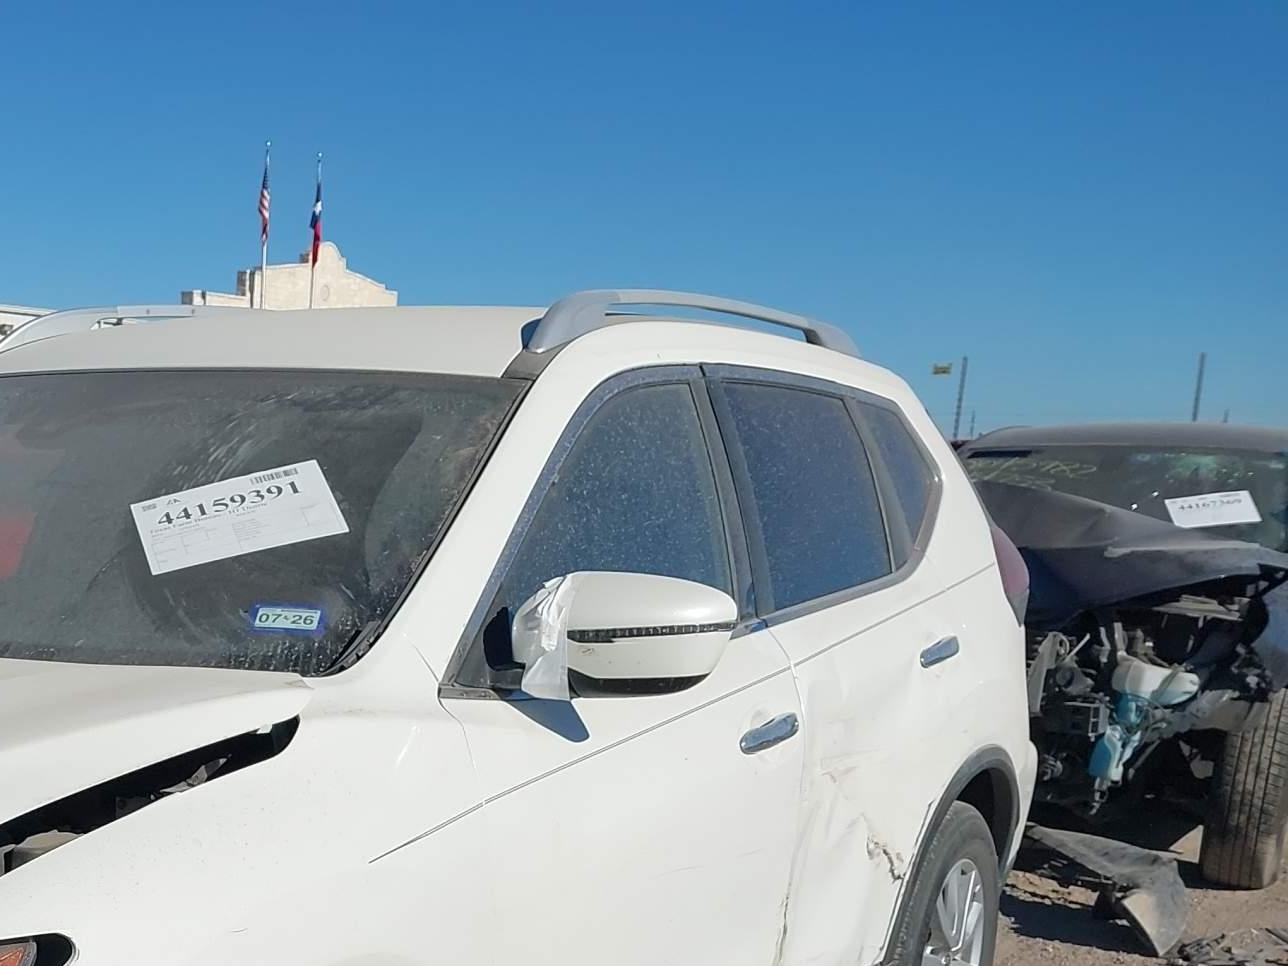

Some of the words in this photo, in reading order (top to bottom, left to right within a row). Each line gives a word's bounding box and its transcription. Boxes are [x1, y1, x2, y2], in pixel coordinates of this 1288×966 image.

[157, 480, 302, 526] 44159391
[258, 613, 282, 623] 07
[290, 614, 315, 625] 26
